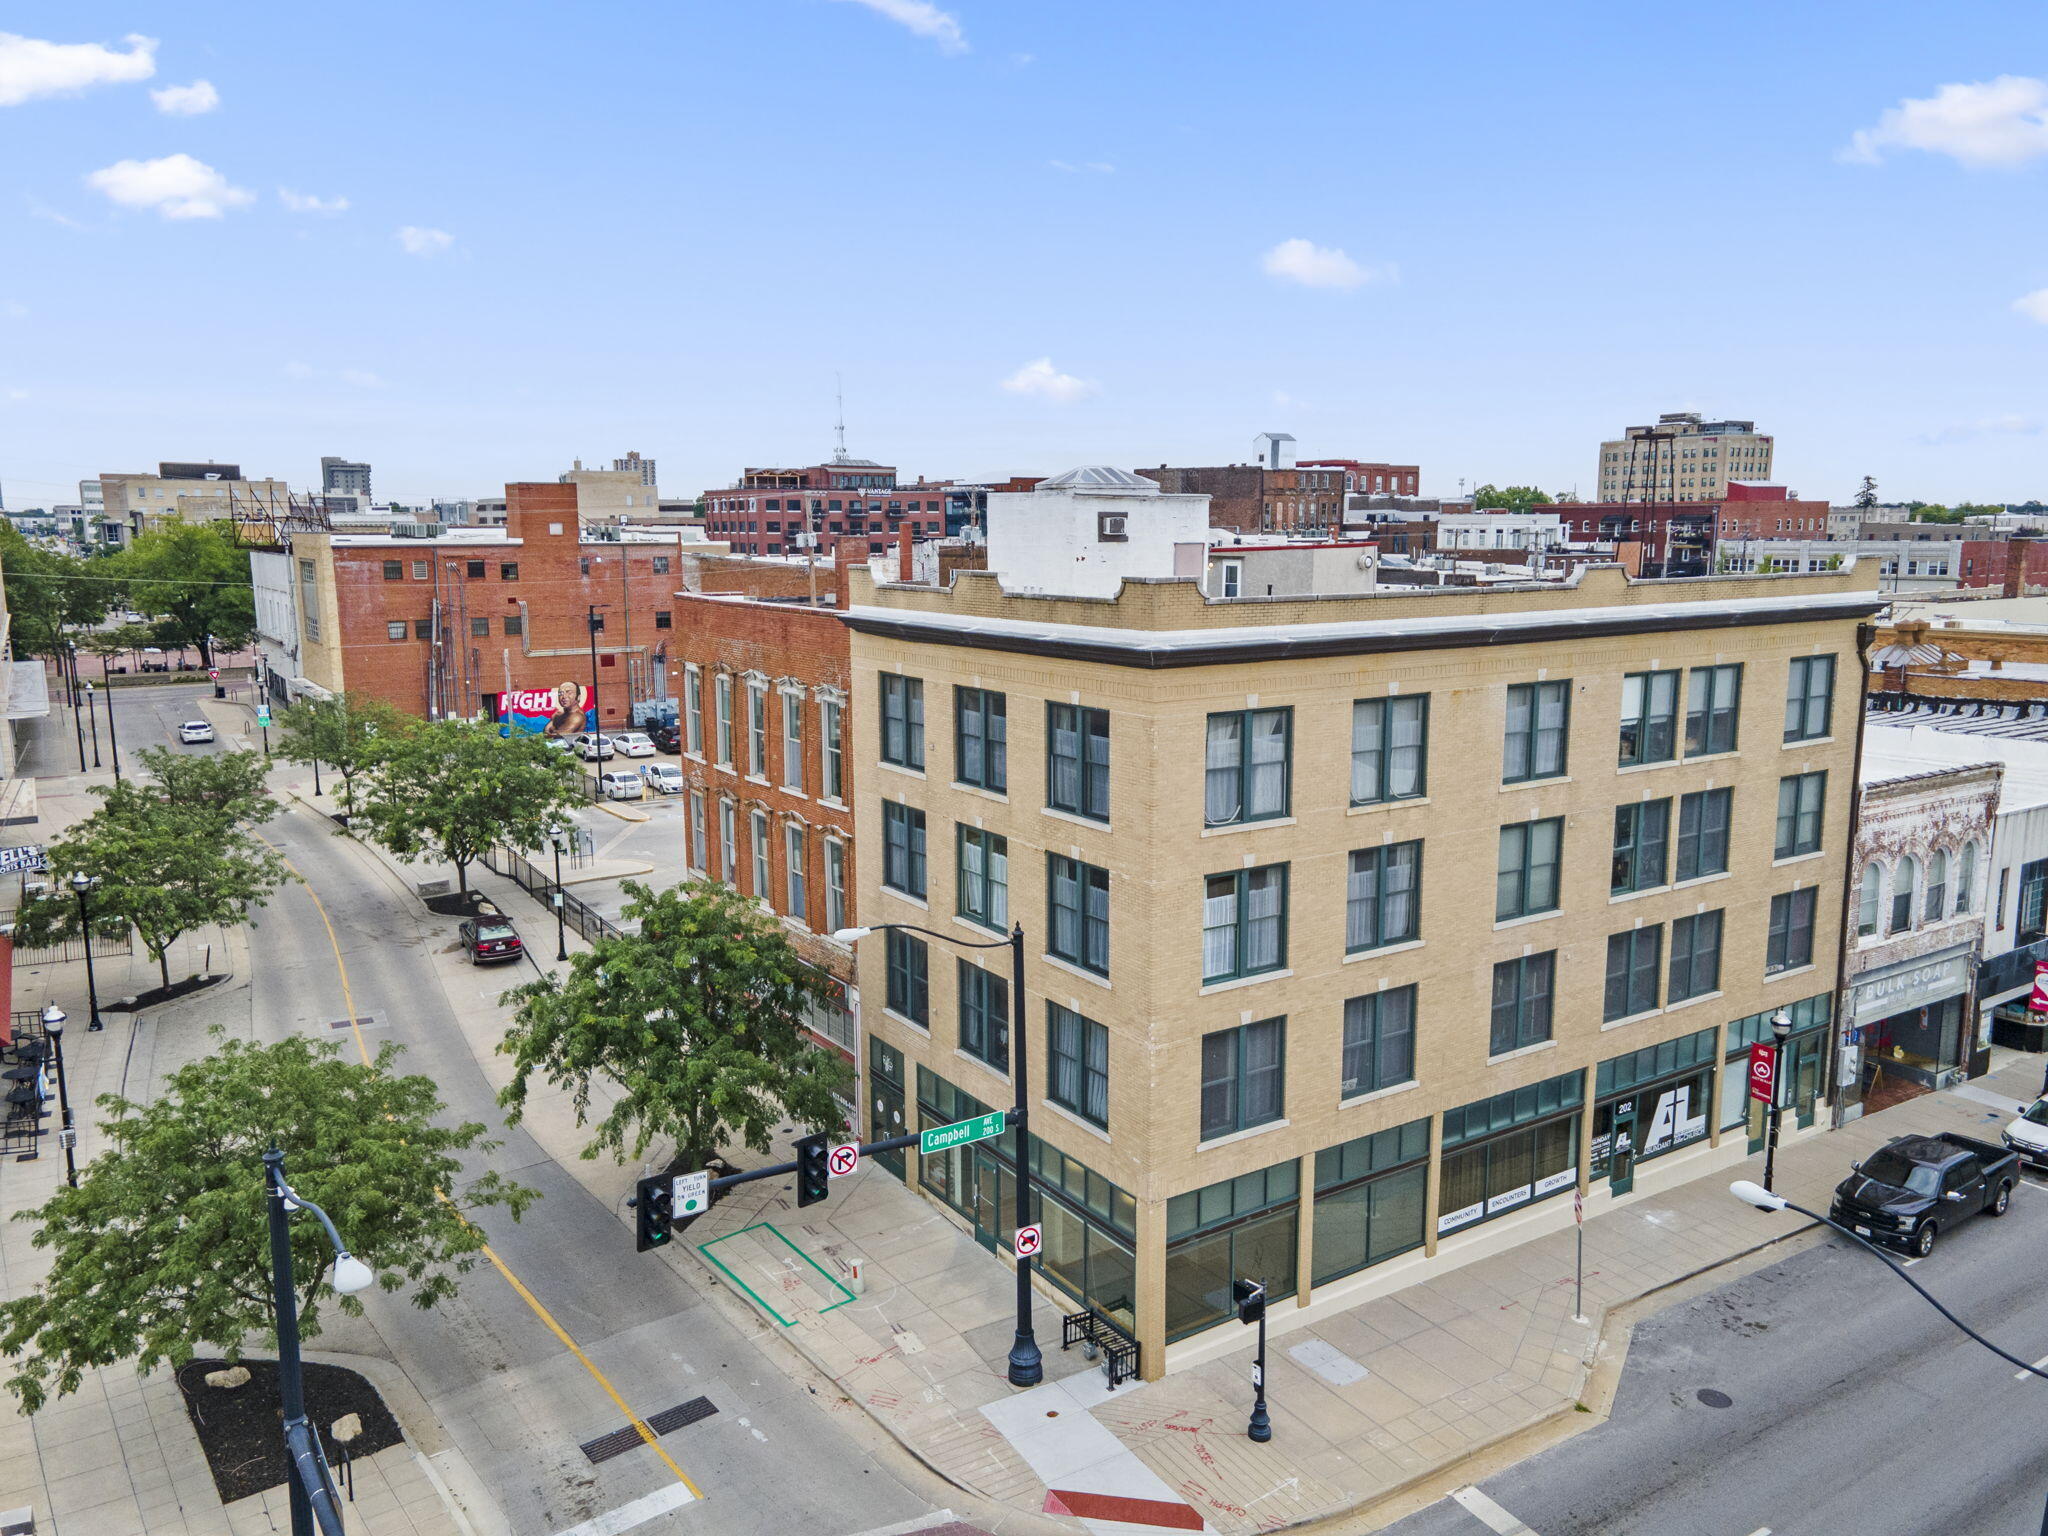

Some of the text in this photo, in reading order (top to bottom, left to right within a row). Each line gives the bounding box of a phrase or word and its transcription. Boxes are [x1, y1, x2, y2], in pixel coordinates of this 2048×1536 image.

[0, 846, 38, 866] ELL'S
[0, 863, 19, 874] ORTS
[1866, 975, 1905, 1000] BULK
[1913, 961, 1952, 986] SOAP
[1618, 1101, 1632, 1114] 202
[983, 1116, 994, 1127] AVE
[927, 1124, 970, 1147] Campbell
[982, 1124, 1000, 1136] 200 S
[676, 1178, 688, 1186] LEFT
[682, 1182, 701, 1192] YIELD
[1544, 1175, 1568, 1188] GROWTH
[688, 1190, 706, 1198] GREEN
[1491, 1189, 1527, 1208] ENCOUNTERS
[1443, 1207, 1479, 1225] COMMUNITY
